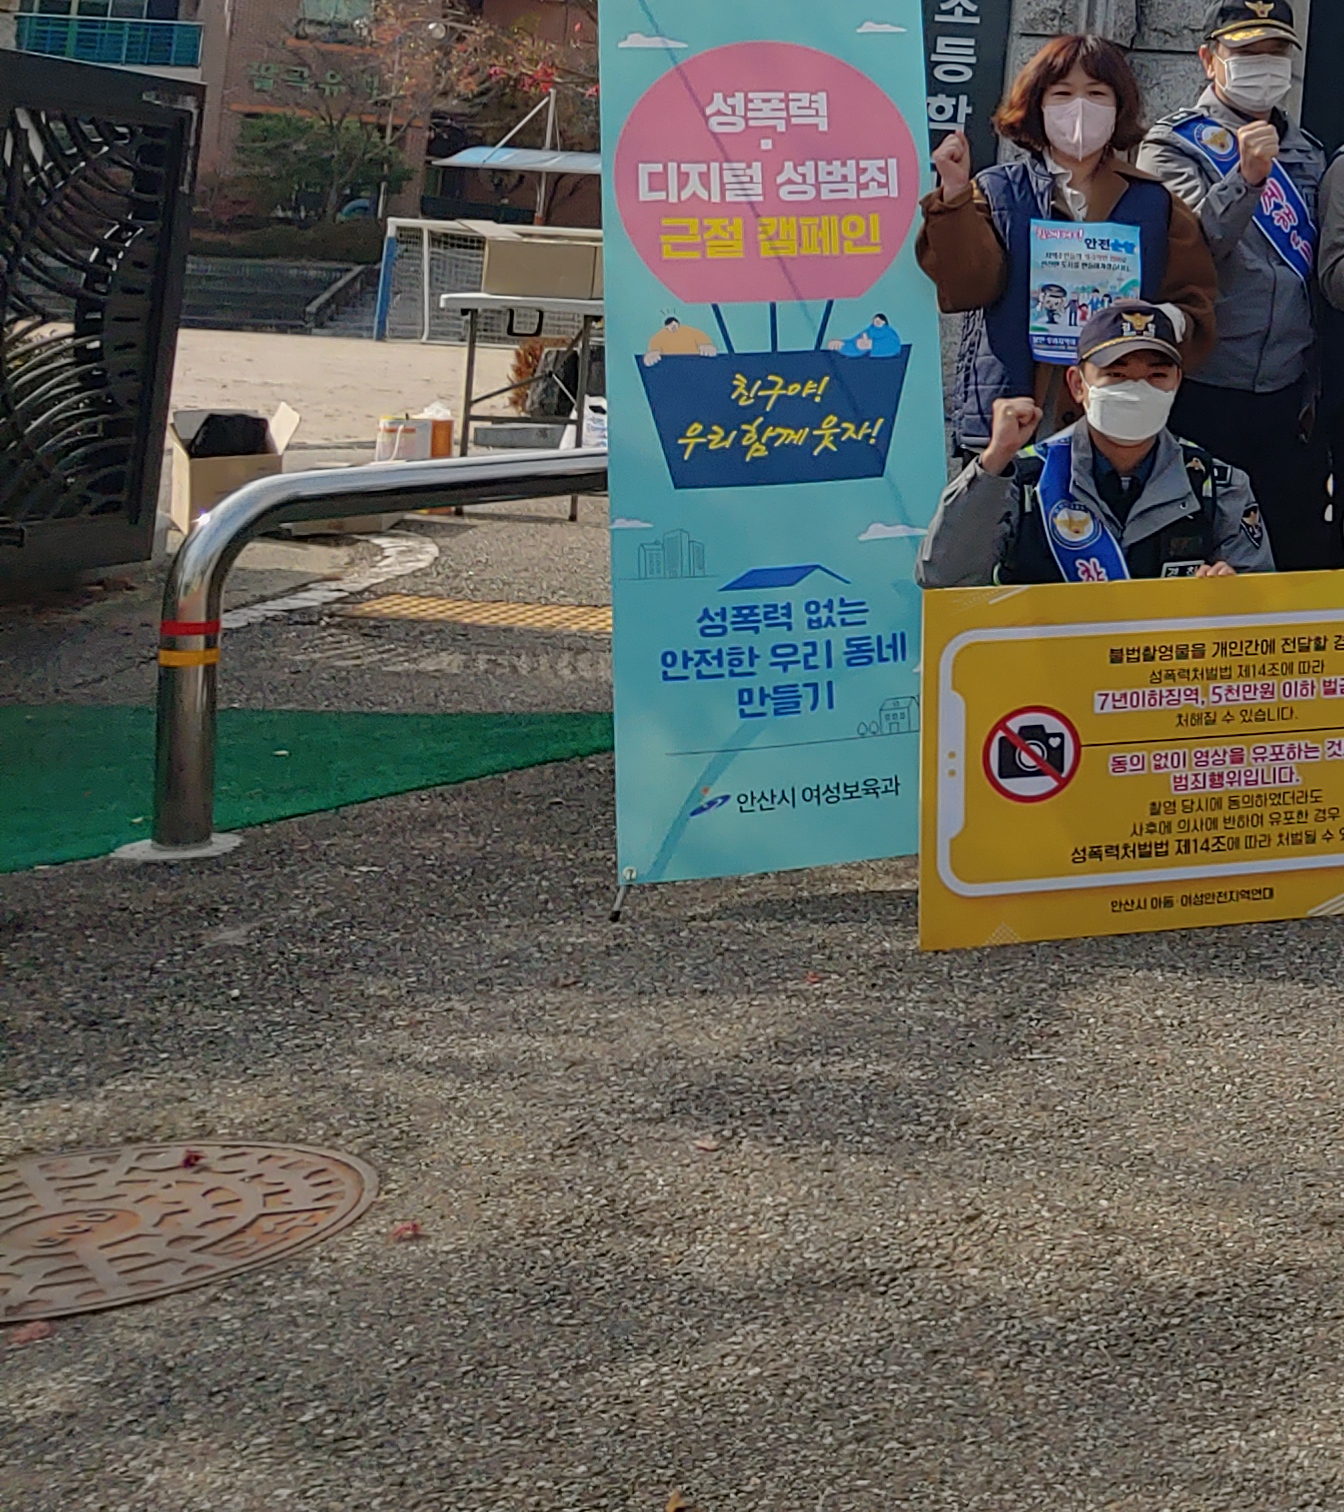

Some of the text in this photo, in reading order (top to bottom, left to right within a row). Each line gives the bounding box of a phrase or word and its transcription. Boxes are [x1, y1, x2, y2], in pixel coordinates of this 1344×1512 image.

[706, 91, 829, 133] 성폭력
[638, 158, 899, 203] 디지털 성범죄
[661, 213, 882, 259] 근절 캠페인
[730, 374, 830, 412] 친구야!
[677, 415, 885, 461] 우리 함께 웃자!
[697, 597, 871, 639] 성폭력 없는
[659, 631, 907, 681] 안전한 우리 동네
[1109, 642, 1207, 664] 불법촬영물을
[1212, 638, 1276, 658] 개인간에
[1281, 635, 1328, 654] 전달할
[1149, 659, 1326, 684] 성폭력처벌법 제14조에 따라
[737, 680, 835, 719] 만들기
[1097, 686, 1207, 710] 7년이하징역,
[1210, 682, 1276, 704] 5천만원
[1282, 679, 1317, 698] 이하
[1175, 706, 1299, 728] 처해질 수 있습니다.
[1110, 754, 1146, 774] 동의
[1153, 750, 1187, 770] 없이
[1193, 747, 1245, 768] 영상을
[1252, 741, 1321, 763] 유포하는
[735, 774, 902, 814] 안산시 여성보육과
[1172, 765, 1301, 792] 범죄행위입니다.
[1149, 789, 1323, 817] 촬영 당시에 동의하였더라도
[1130, 808, 1341, 838] 사후에 의사에 반하여 유포한 경우
[1071, 841, 1169, 864] 성폭력처벌법
[1175, 835, 1241, 855] 제14조에
[1244, 834, 1272, 850] 따라
[1276, 829, 1318, 847] 처벌될
[1321, 827, 1333, 844] 수
[1111, 898, 1147, 913] 안산시
